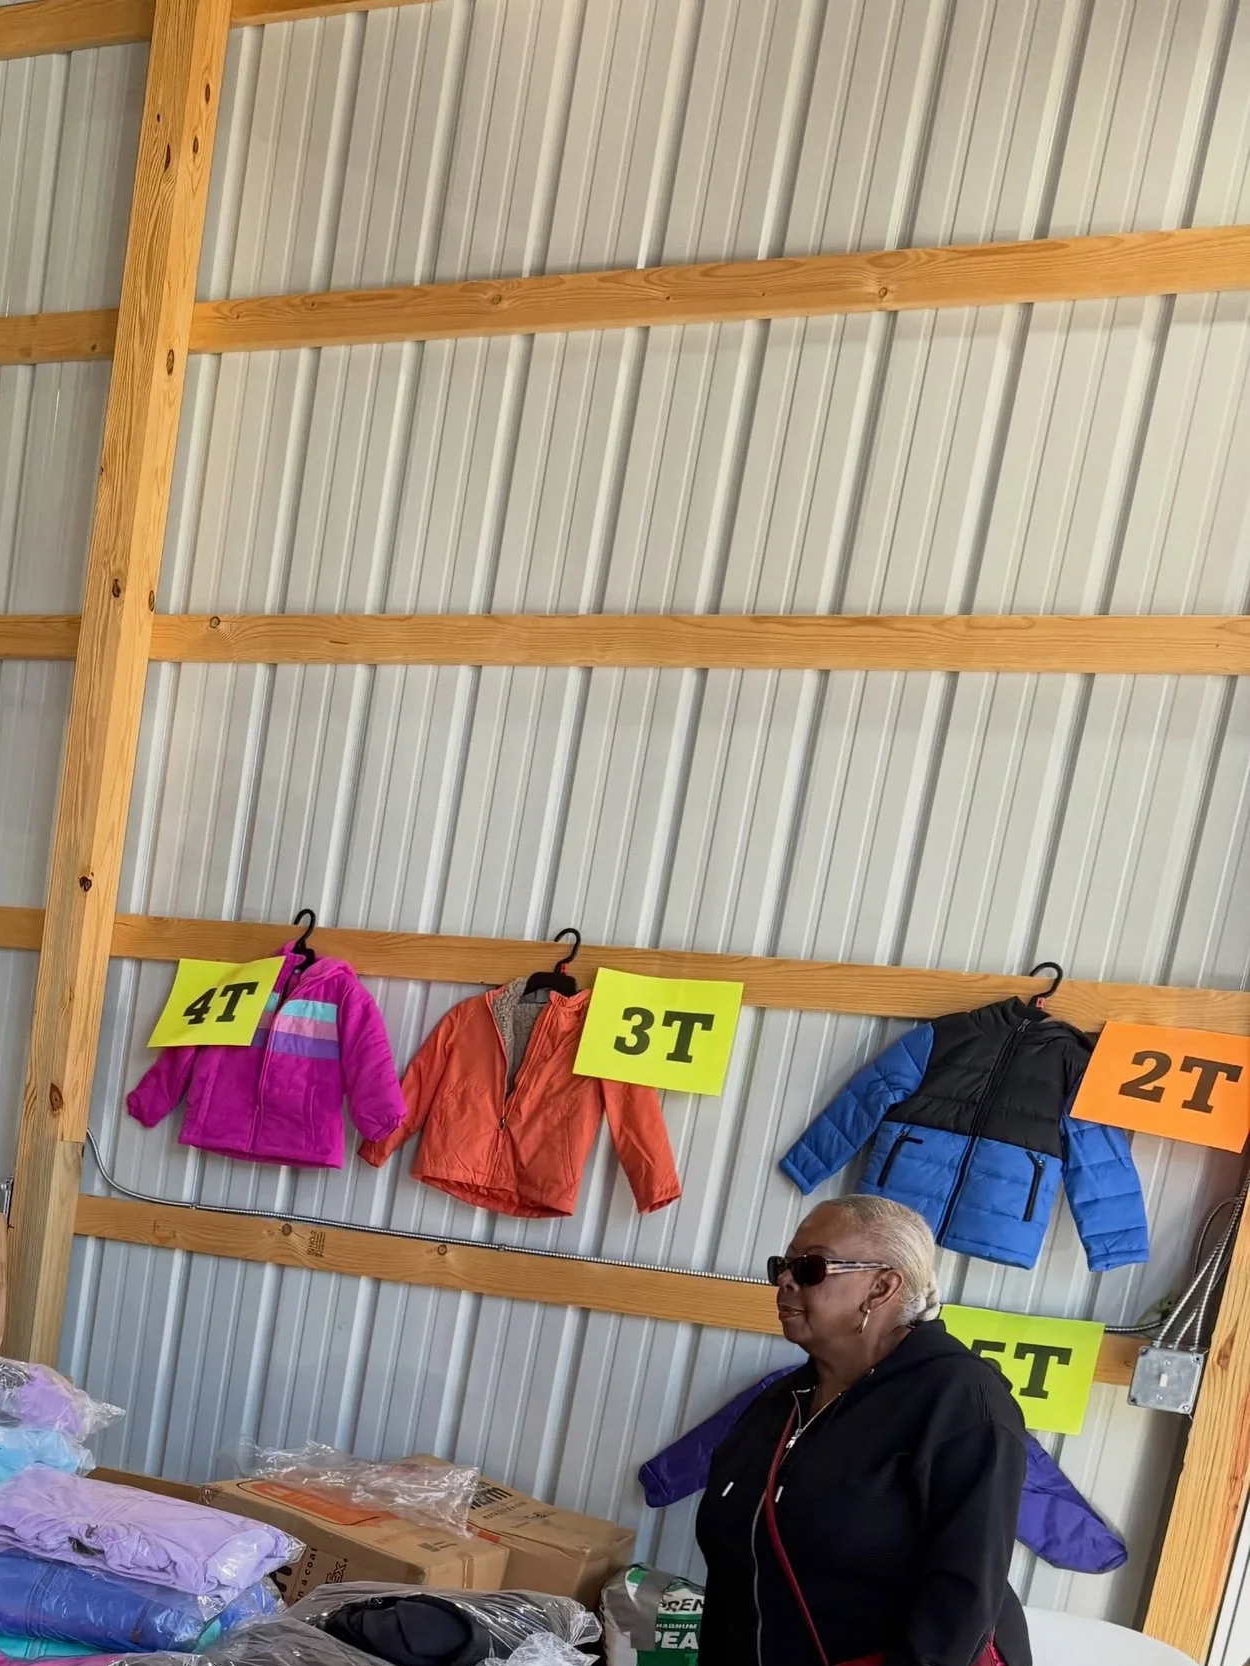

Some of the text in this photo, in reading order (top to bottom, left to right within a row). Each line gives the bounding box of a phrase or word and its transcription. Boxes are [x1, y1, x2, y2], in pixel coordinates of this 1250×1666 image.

[182, 981, 260, 1025] 4T
[613, 1006, 715, 1064] 3T
[1118, 1050, 1243, 1115] 2T
